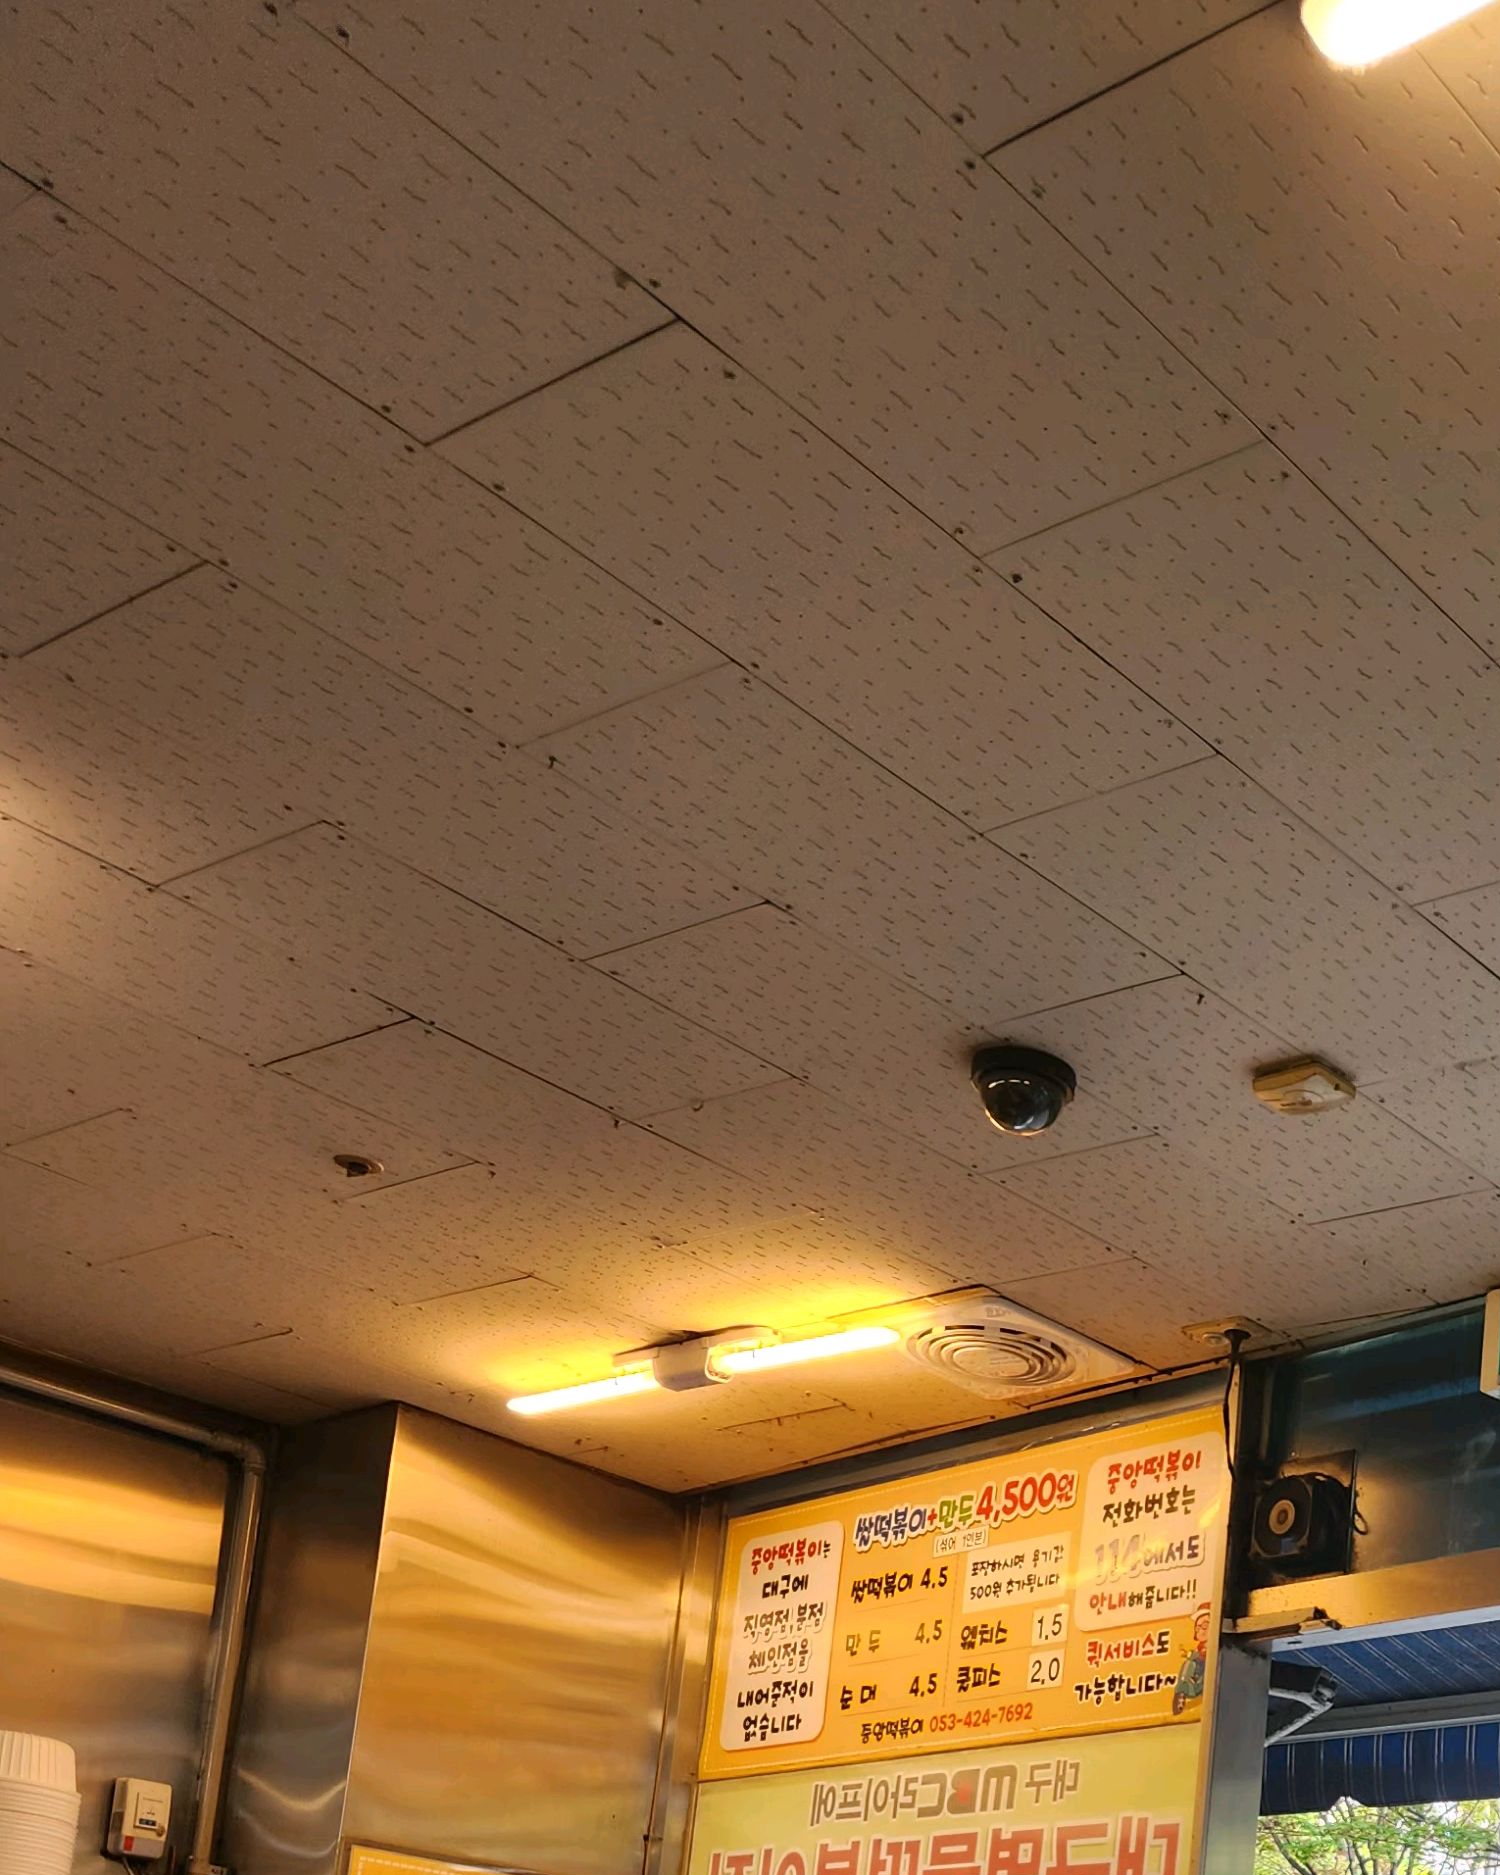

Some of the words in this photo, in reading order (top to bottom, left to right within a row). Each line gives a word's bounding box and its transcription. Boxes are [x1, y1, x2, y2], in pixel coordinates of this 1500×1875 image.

[1107, 1449, 1202, 1495] 중앙떡볶이
[1102, 1484, 1196, 1528] 전화번호는
[751, 1537, 831, 1576] 중앙떡볶이는
[762, 1574, 809, 1599] 대구에
[850, 1571, 914, 1604] 쌀떡볶이
[920, 1565, 949, 1589] 4.5
[970, 1582, 1003, 1600] 500원
[1006, 1573, 1061, 1595] 추가됩니다
[914, 1619, 943, 1644] 4.5
[1037, 1612, 1063, 1642] 1.5
[748, 1638, 809, 1670] 체인점을
[1087, 1630, 1170, 1669] 퀵서비스도
[909, 1672, 938, 1697] 4.5
[1030, 1656, 1061, 1686] 2.0
[737, 1679, 814, 1708] 내어준적이
[743, 1712, 802, 1743] 없습니다
[929, 1702, 1034, 1733] 053-424-7692
